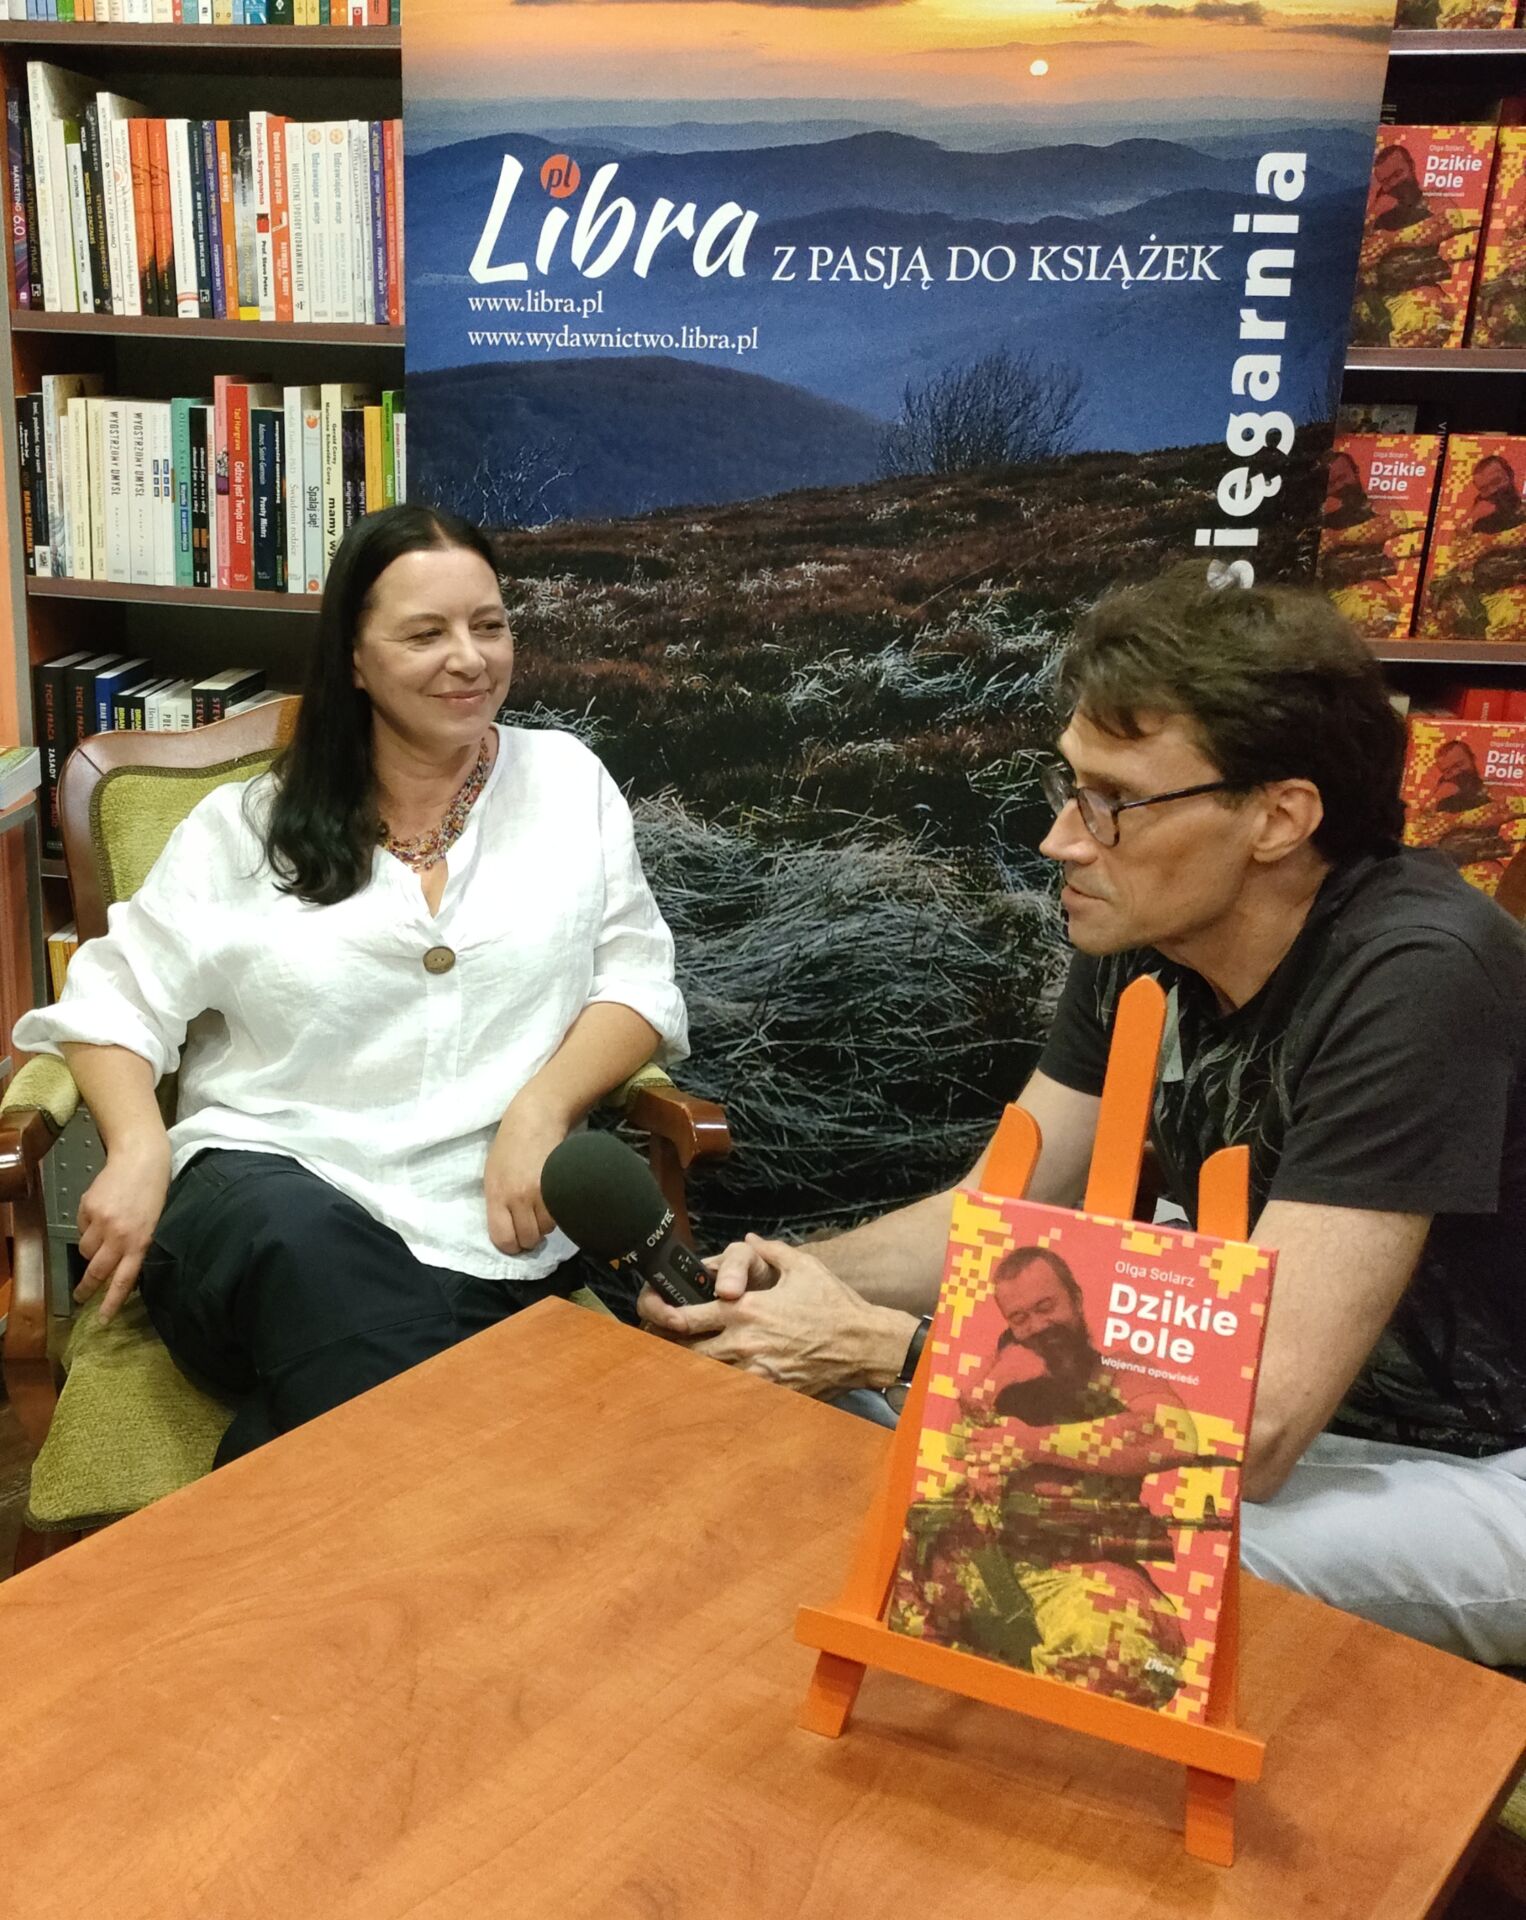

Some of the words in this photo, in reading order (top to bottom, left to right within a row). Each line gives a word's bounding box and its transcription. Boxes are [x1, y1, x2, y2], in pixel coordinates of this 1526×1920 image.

[1426, 154, 1482, 171] Dzikie
[13, 165, 22, 212] MARKETING
[257, 160, 266, 205] Szympansa
[1423, 172, 1464, 188] Pole
[13, 215, 25, 236] 6.0
[468, 153, 760, 285] Libra
[771, 245, 797, 282] Z
[807, 245, 935, 290] PASJĄ
[946, 245, 1016, 282] DO
[1028, 234, 1223, 290] KSIĄŻEK
[468, 290, 604, 319] www.libra.pl
[468, 324, 759, 355] www.wydawnictwo.libra.pl
[234, 408, 242, 420] Tad
[233, 420, 242, 451] Hargrave
[235, 461, 244, 483] Gdzie
[1370, 461, 1426, 477] Dzikie
[135, 470, 145, 497] UMYSŁ
[234, 484, 244, 497] jest
[1368, 477, 1408, 492] Pole
[234, 499, 245, 520] Twoja
[258, 496, 268, 517] Prosty
[290, 484, 300, 523] Świadomi
[308, 486, 320, 511] Spalaj
[260, 518, 268, 538] Mistrz
[308, 513, 319, 528] się!
[327, 497, 338, 536] mamy
[236, 521, 245, 544] nisza?
[291, 526, 299, 556] rodzice
[118, 707, 126, 729] BRIAN
[134, 708, 142, 730] BRIAN
[48, 748, 56, 779] ZASADY
[1484, 764, 1524, 779] Pole
[1115, 1260, 1147, 1278] Olga
[1149, 1267, 1195, 1288] Solarz
[1108, 1282, 1238, 1337] Dzikie
[1103, 1316, 1195, 1364] Pole
